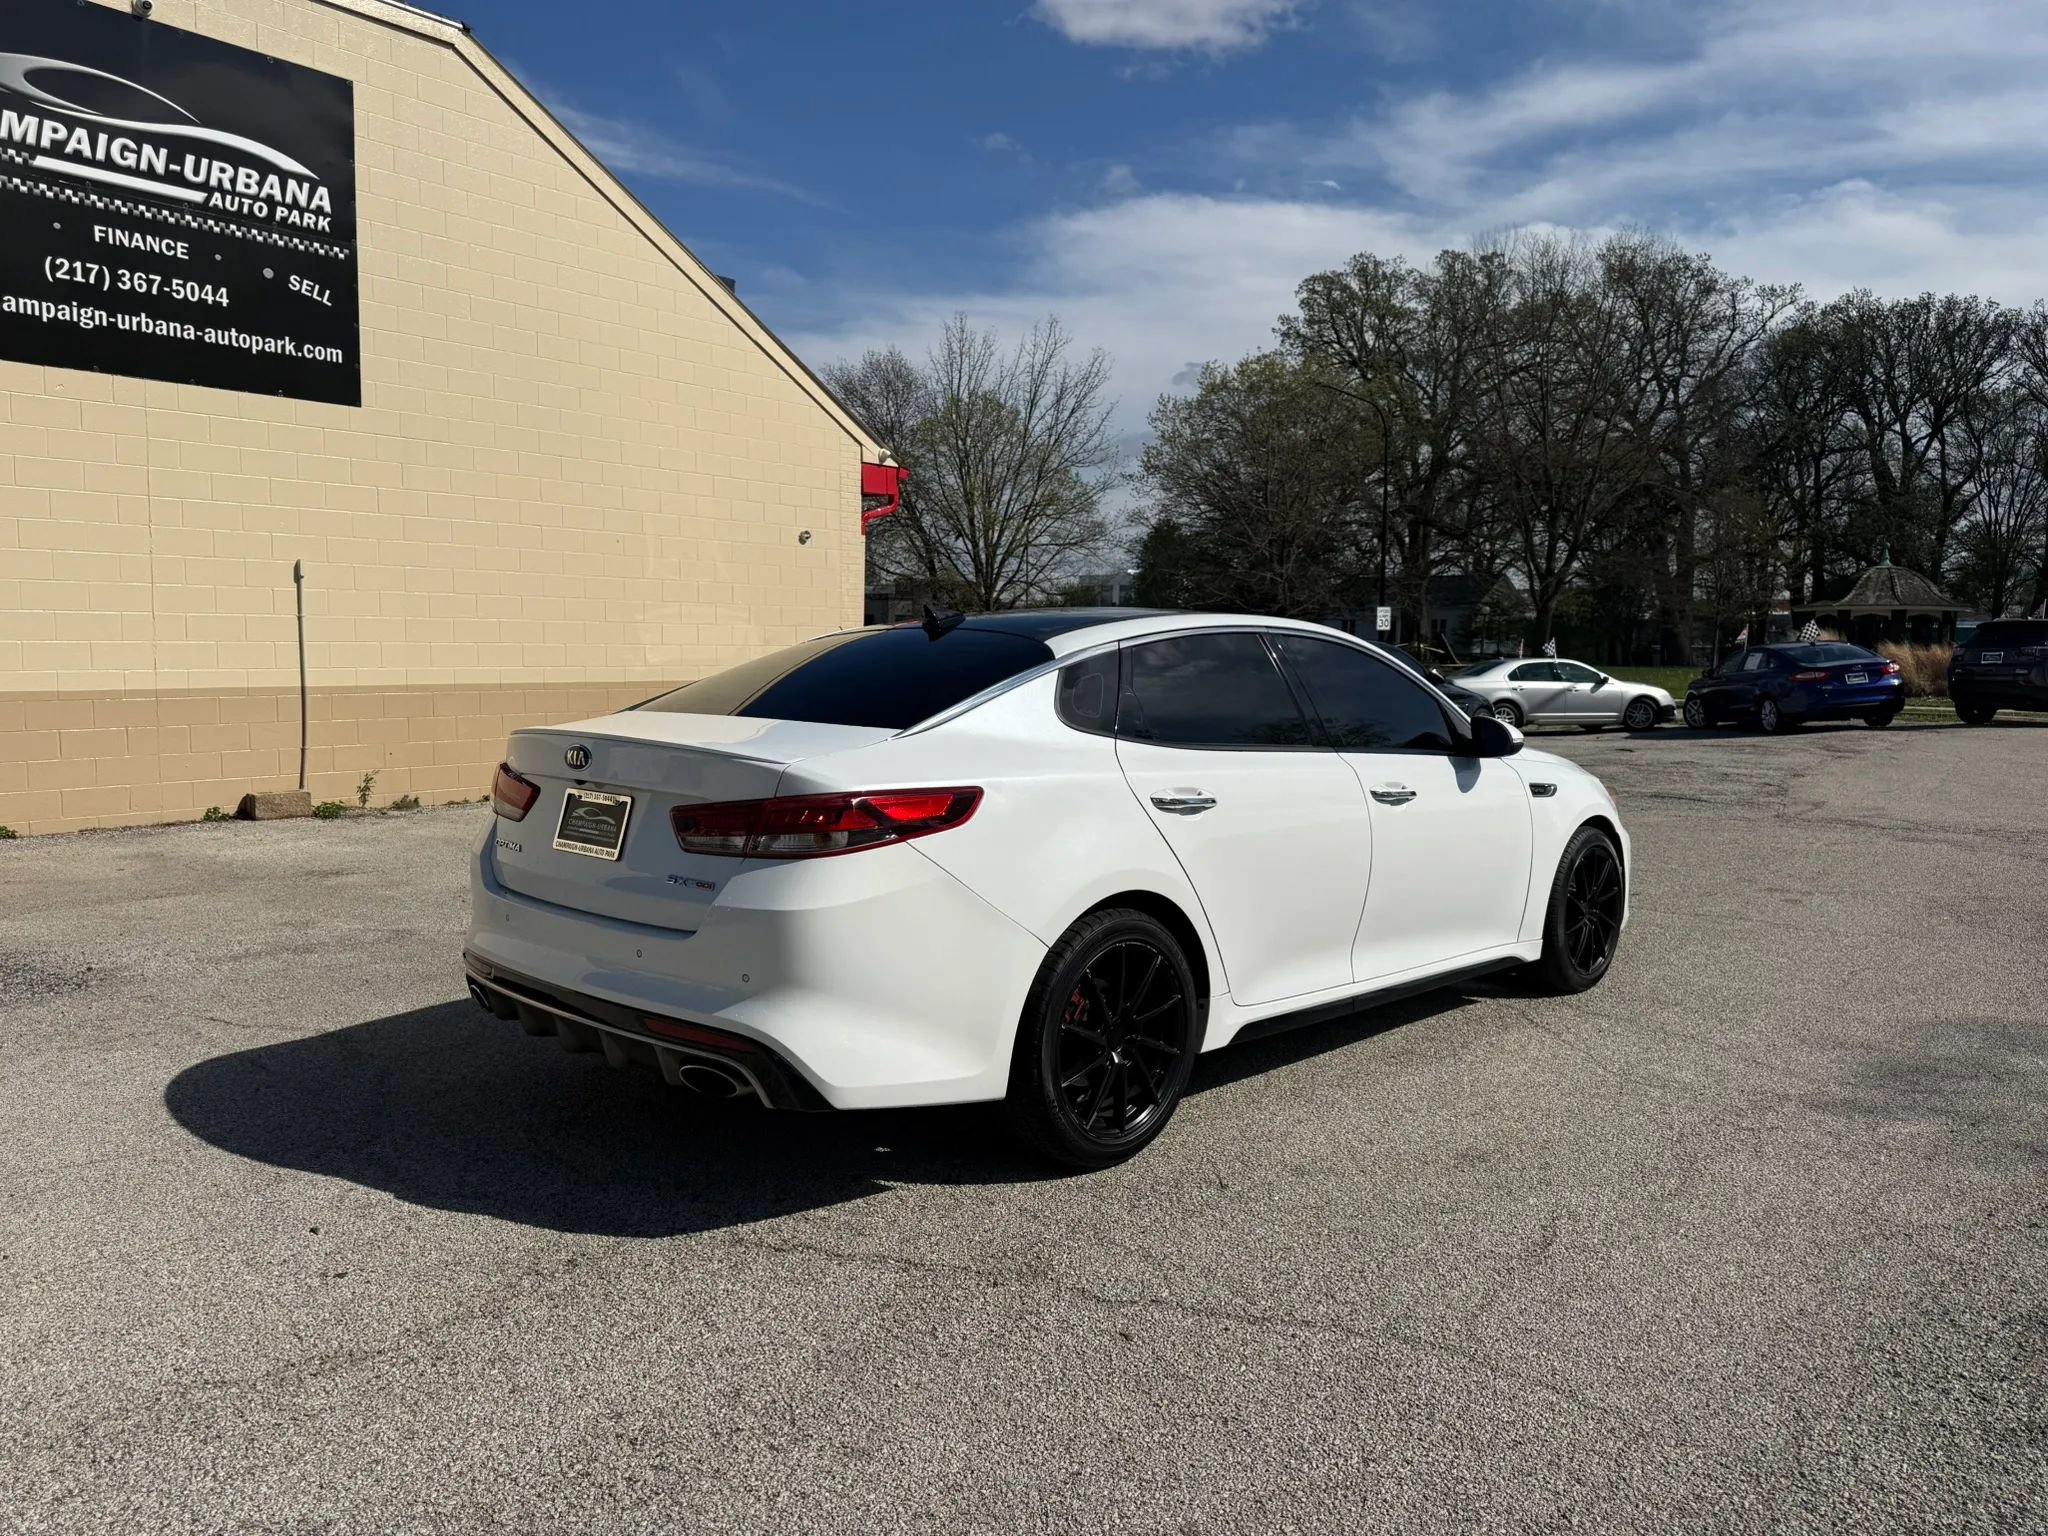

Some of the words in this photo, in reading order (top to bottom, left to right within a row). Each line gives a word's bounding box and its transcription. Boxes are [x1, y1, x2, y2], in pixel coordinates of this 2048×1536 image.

[0, 109, 332, 214] MPAIGN-URBANA
[208, 192, 269, 218] AUTO
[275, 207, 331, 232] PARK
[93, 225, 190, 260] FINANCE
[44, 256, 111, 291] (217)
[117, 269, 229, 307] 367-5044
[288, 274, 333, 306] SELL
[2, 295, 343, 364] ampaign-urbana-autopark.com
[1379, 618, 1389, 628] 30
[567, 750, 585, 765] KIA
